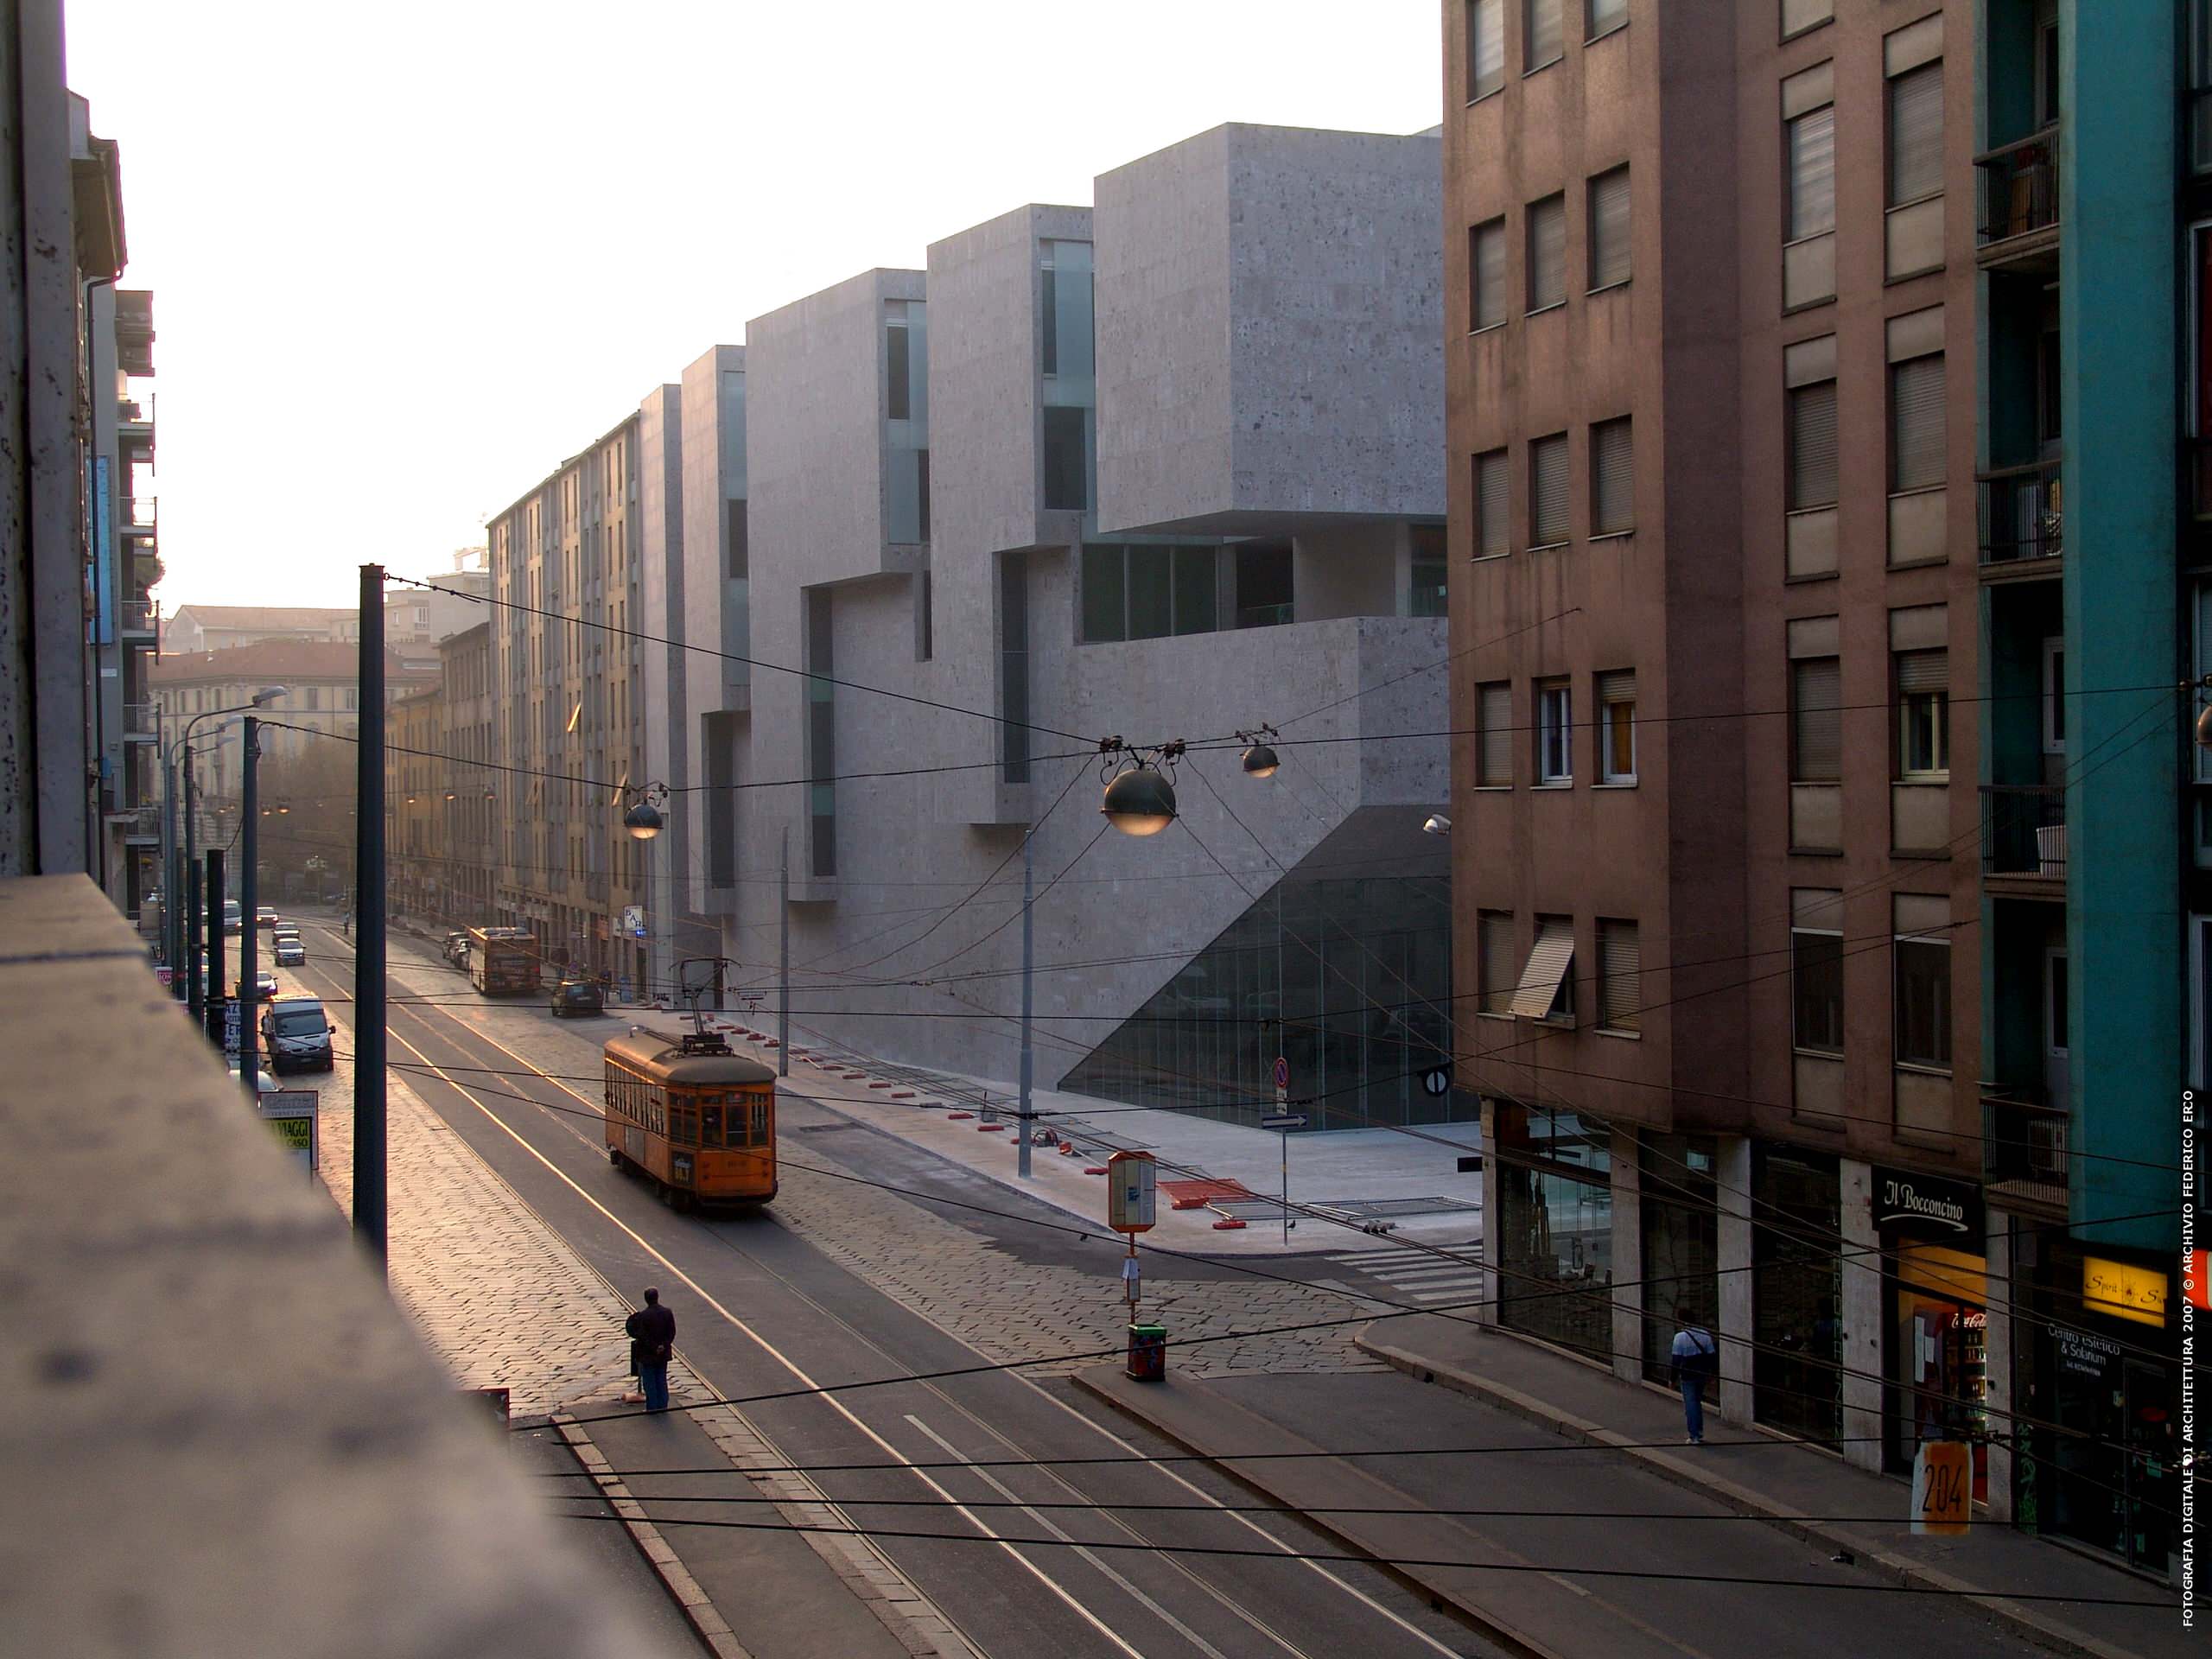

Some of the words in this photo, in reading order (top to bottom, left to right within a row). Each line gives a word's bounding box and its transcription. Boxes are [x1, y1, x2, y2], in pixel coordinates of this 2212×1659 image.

[1900, 1184, 1963, 1221] Bocconcino
[2085, 1274, 2118, 1294] Spirit
[2048, 1323, 2079, 1344] Centro
[2082, 1334, 2120, 1356] estetico
[2060, 1340, 2068, 1354] &
[2069, 1343, 2107, 1367] Solarium
[1921, 1463, 1962, 1512] 204
